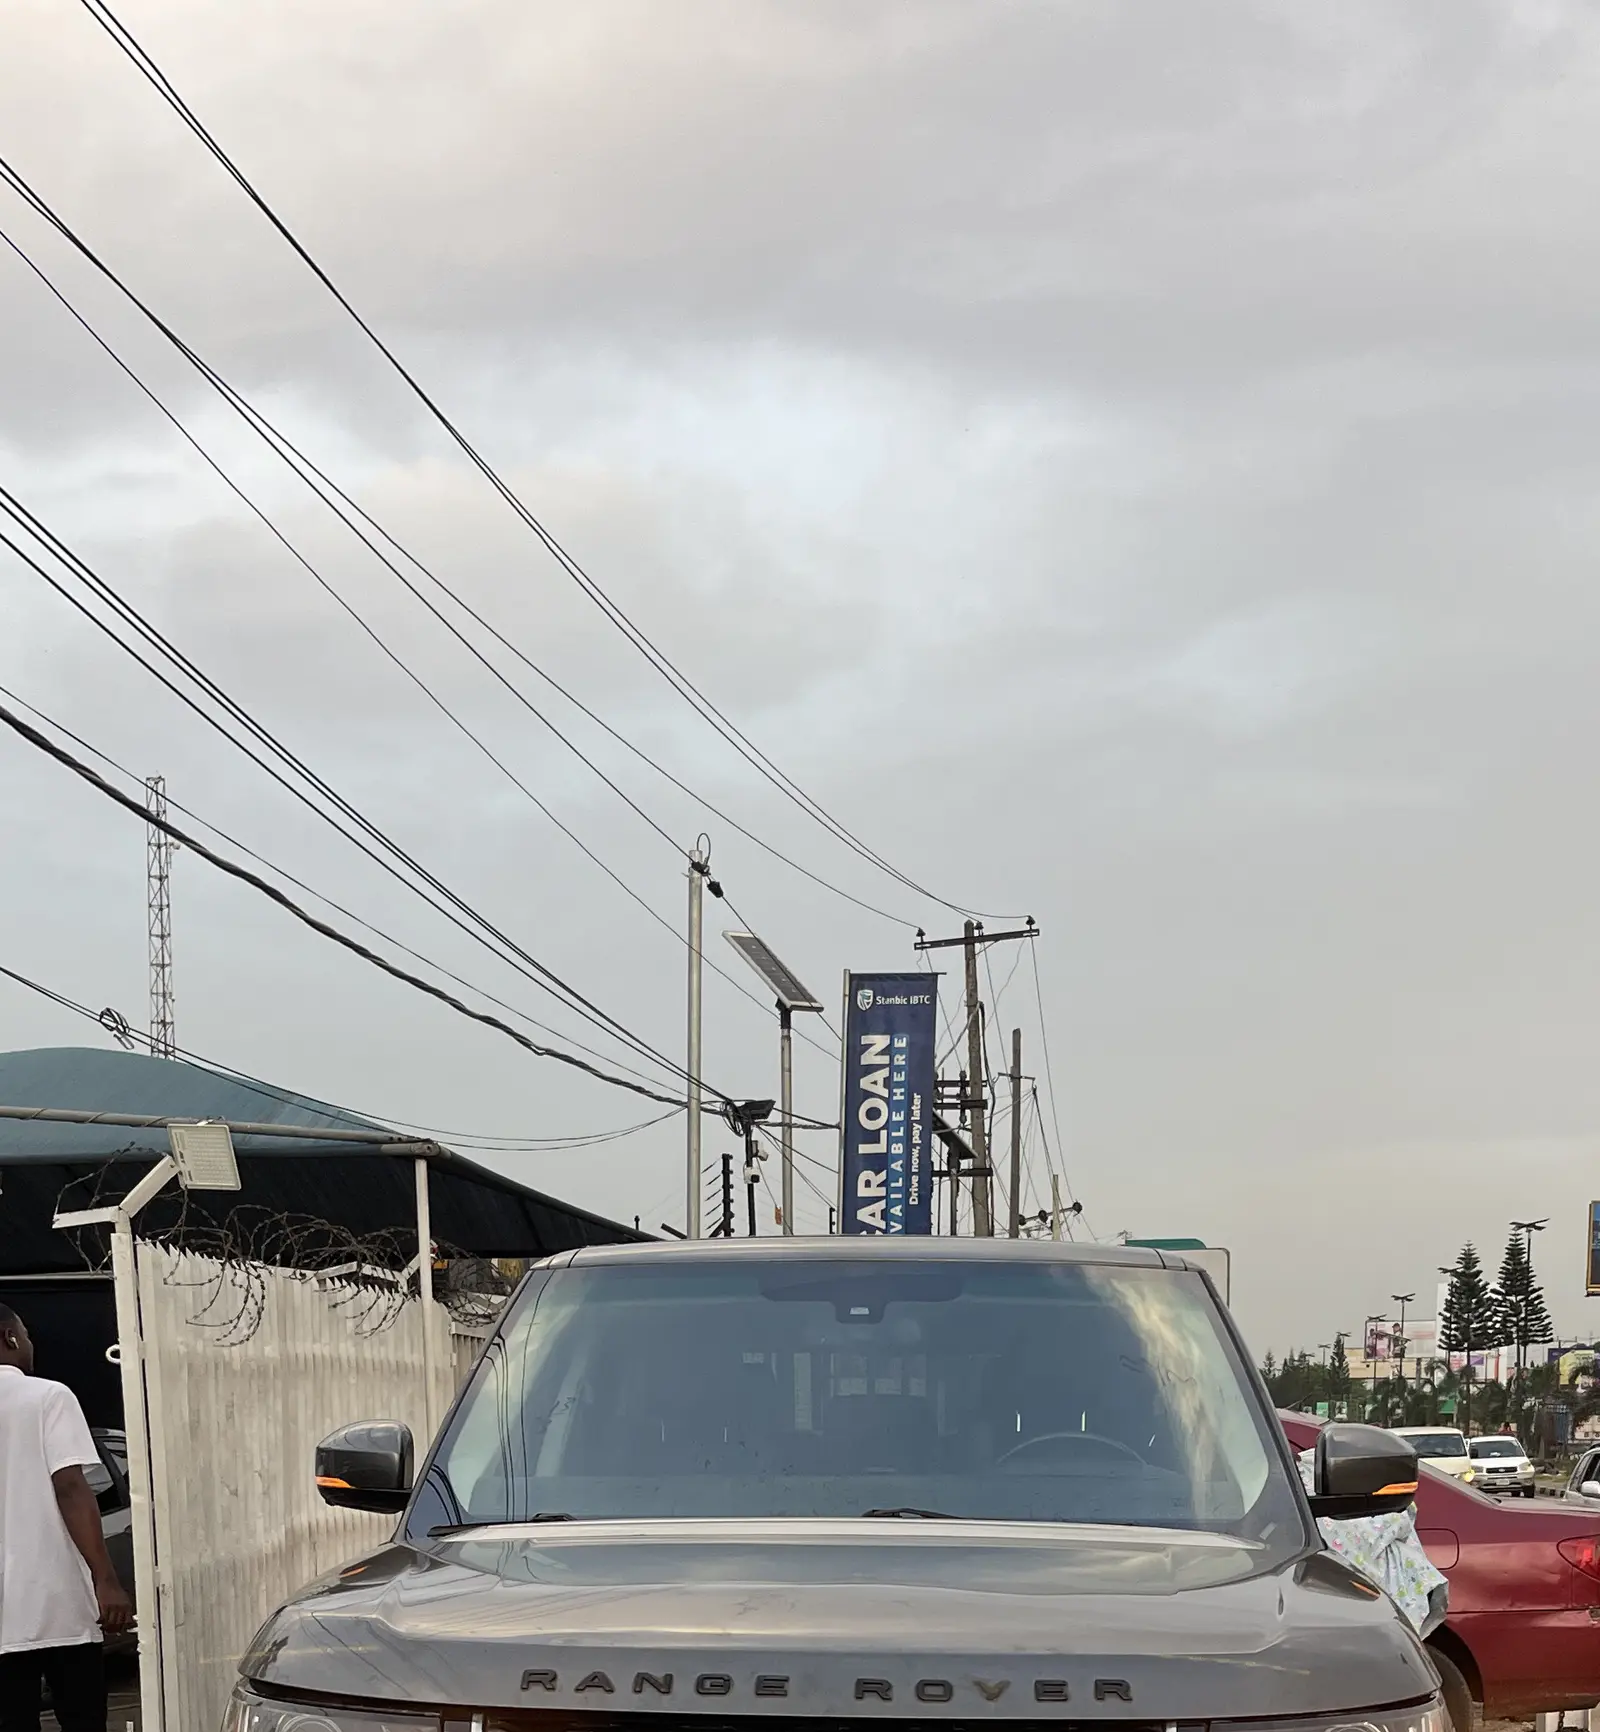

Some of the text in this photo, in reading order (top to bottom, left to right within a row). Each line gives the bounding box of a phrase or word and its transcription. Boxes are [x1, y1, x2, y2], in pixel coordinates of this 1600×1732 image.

[875, 995, 931, 1005] Stanbic IBTC
[857, 1034, 891, 1235] AR LOAN
[890, 1037, 907, 1234] VAILABLE HERE
[909, 1092, 923, 1205] Drive now, pay later
[520, 1668, 1133, 1702] RANGE ROVER
